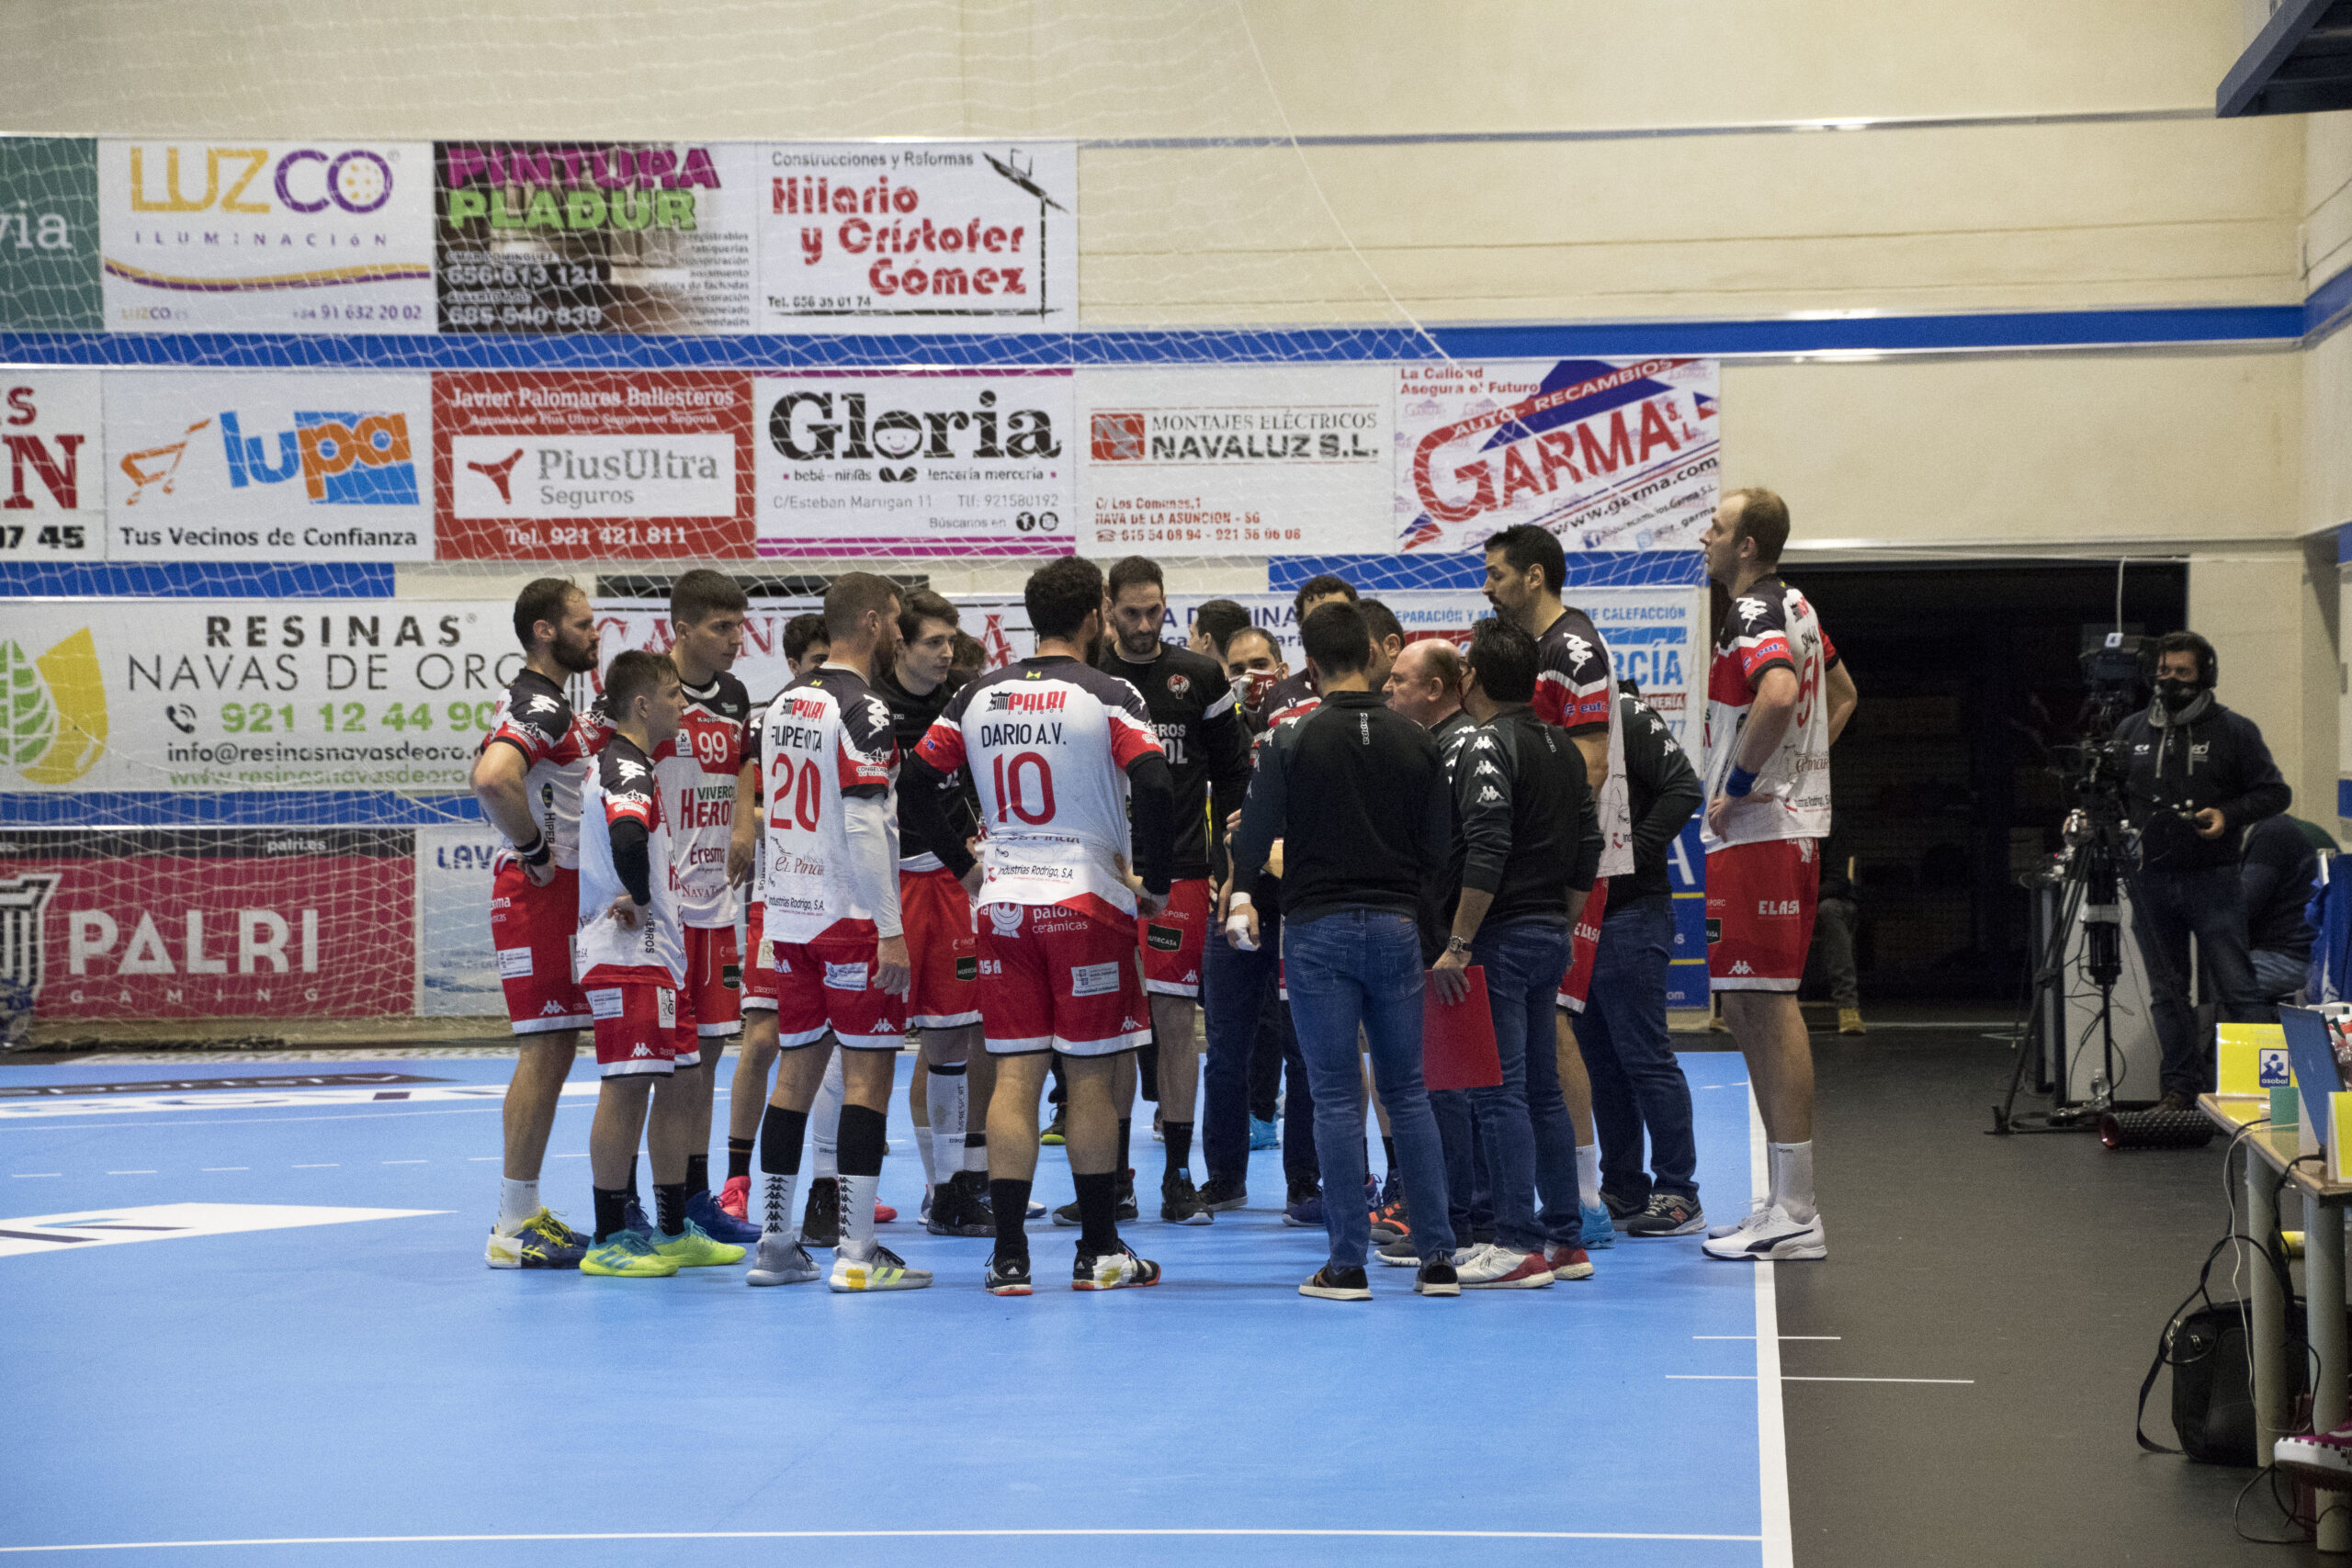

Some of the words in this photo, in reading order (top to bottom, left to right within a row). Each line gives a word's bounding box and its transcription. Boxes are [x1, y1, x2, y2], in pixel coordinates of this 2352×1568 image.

[448, 148, 721, 189] PINTURA
[773, 151, 888, 167] Construcciones
[891, 156, 900, 168] y
[904, 151, 974, 166] Reformas
[130, 147, 393, 214] LUZCO
[773, 175, 920, 215] Hilario
[448, 189, 697, 231] PLADUR
[800, 227, 823, 266] y
[868, 258, 1027, 297] Gómez
[321, 305, 340, 321] 91
[379, 305, 399, 321] 20
[403, 305, 422, 321] 02
[768, 296, 789, 309] Tel.
[856, 296, 871, 309] 74
[1400, 367, 1419, 379] La
[1533, 358, 1673, 411] RECAMBIOS
[451, 387, 512, 408] Javier
[518, 386, 621, 408] Palomares
[627, 385, 735, 407] Ballesteros
[1400, 382, 1464, 396] Asegura
[1488, 382, 1541, 394] Futuro
[768, 389, 1062, 461] Gloria
[1151, 414, 1254, 432] MONTAJES
[1260, 410, 1378, 431] ELÉCTRICOS
[219, 410, 413, 501] lupa
[1151, 434, 1312, 460] NAVALUZ
[1318, 433, 1379, 458] S.L.
[537, 448, 719, 480] PlusUltra
[1413, 399, 1682, 524] GARMA
[541, 484, 635, 510] Seguros
[773, 494, 846, 509] C/Esteban
[1112, 497, 1132, 509] Los
[1553, 456, 1718, 536] www.garma.com
[1095, 512, 1126, 525] NAVA
[1130, 513, 1147, 525] DE
[1150, 512, 1165, 525] LA
[1169, 512, 1232, 525] ASUNCION
[38, 525, 85, 549] 45
[120, 526, 161, 547] Tus
[167, 525, 259, 547] Vecinos
[267, 526, 295, 547] de
[303, 526, 418, 547] Confianza
[505, 528, 544, 547] Tel.
[550, 527, 590, 545] 921
[598, 527, 638, 545] 421
[646, 526, 687, 544] 811
[1602, 605, 1686, 621] CALEFACCIÓN
[206, 615, 462, 648] RESINAS
[128, 653, 300, 692] NAVAS
[326, 653, 389, 691] DE
[1007, 690, 1068, 712] PALRI
[220, 702, 296, 733] 921
[318, 702, 368, 733] 12
[380, 702, 434, 732] 44
[698, 731, 729, 764] 99
[980, 723, 1032, 749] DARIO
[1035, 722, 1067, 746] A.V.
[769, 752, 821, 832] 20
[993, 750, 1057, 826] 10
[997, 864, 1031, 877] Industrias
[1031, 864, 1060, 879] Rodrigo,
[1032, 919, 1089, 935] cerámicas
[69, 908, 319, 975] PALRI
[70, 988, 319, 1005] GAMING
[2261, 1077, 2289, 1086] asobal
